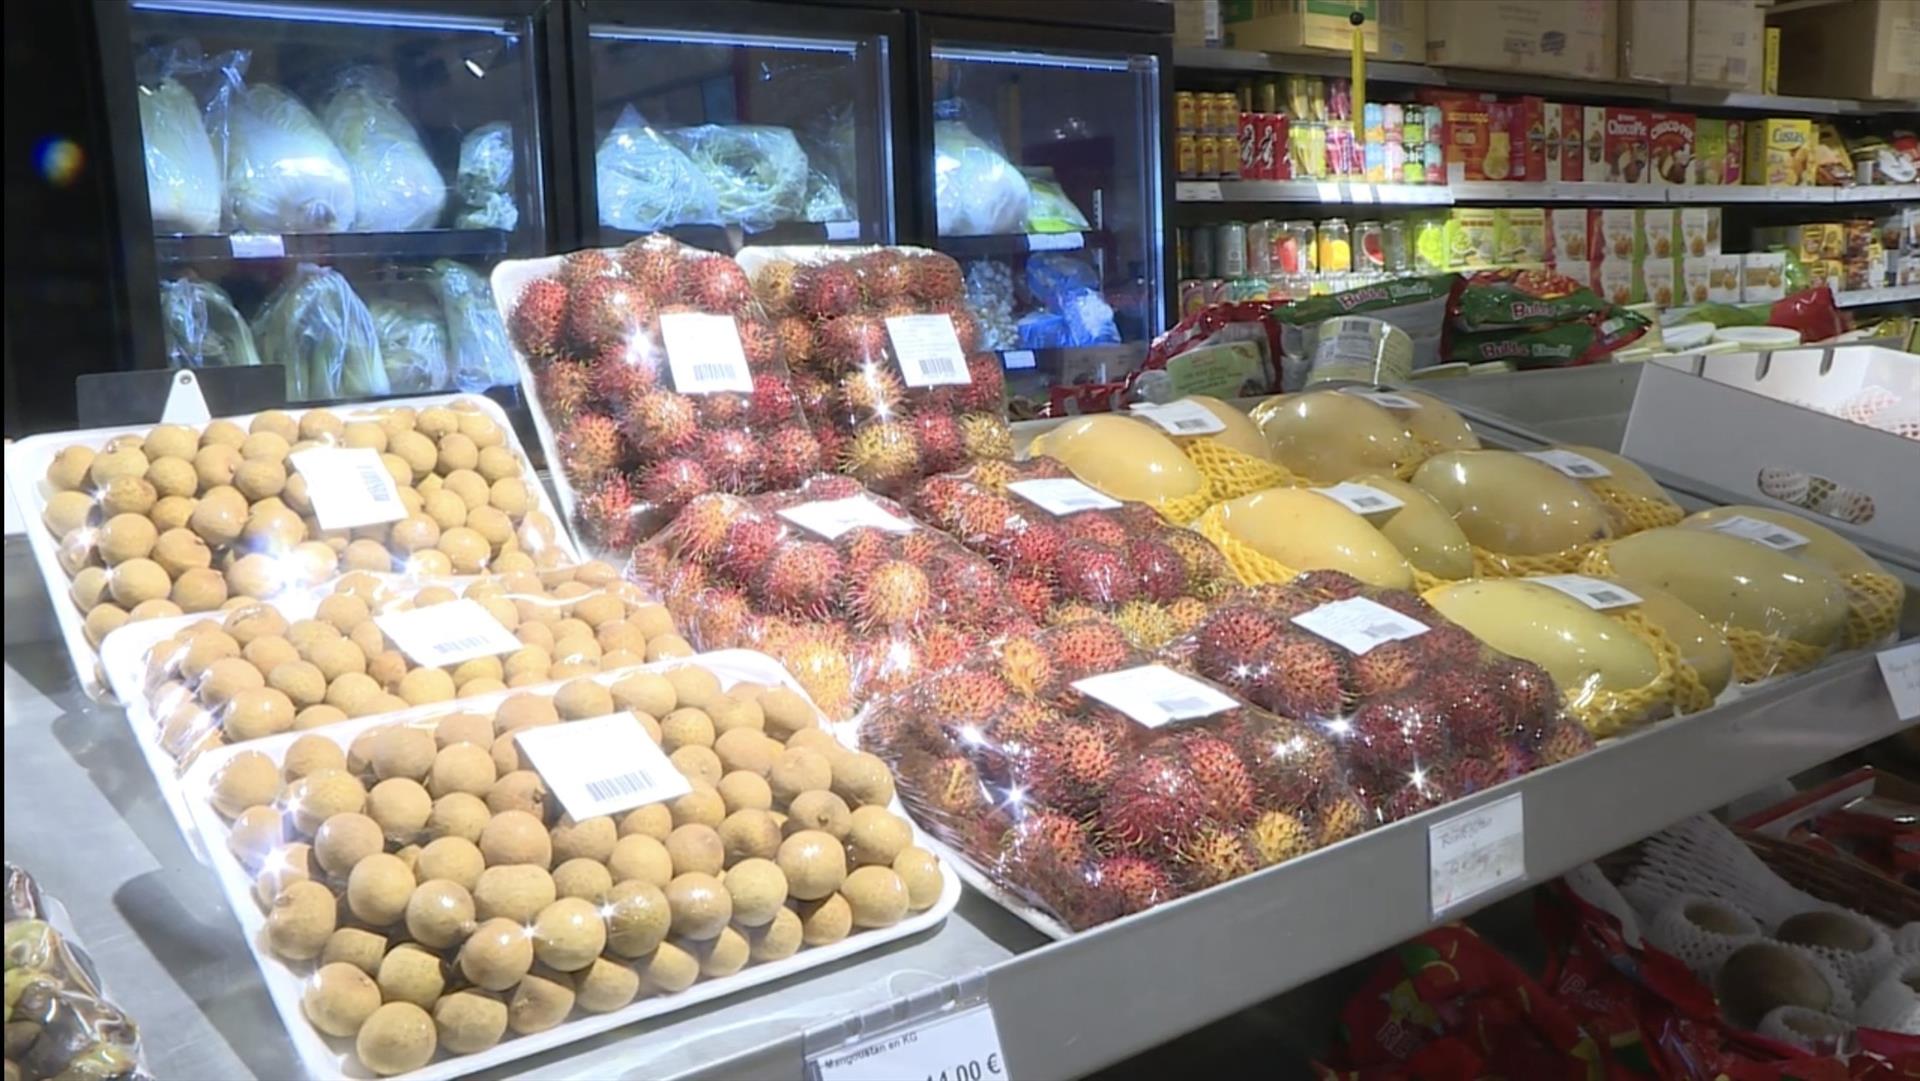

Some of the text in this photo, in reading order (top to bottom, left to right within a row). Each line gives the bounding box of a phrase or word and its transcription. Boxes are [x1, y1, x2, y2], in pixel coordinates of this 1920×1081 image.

[888, 1039, 901, 1050] en
[902, 1033, 918, 1046] KG
[986, 1053, 1001, 1074] €
